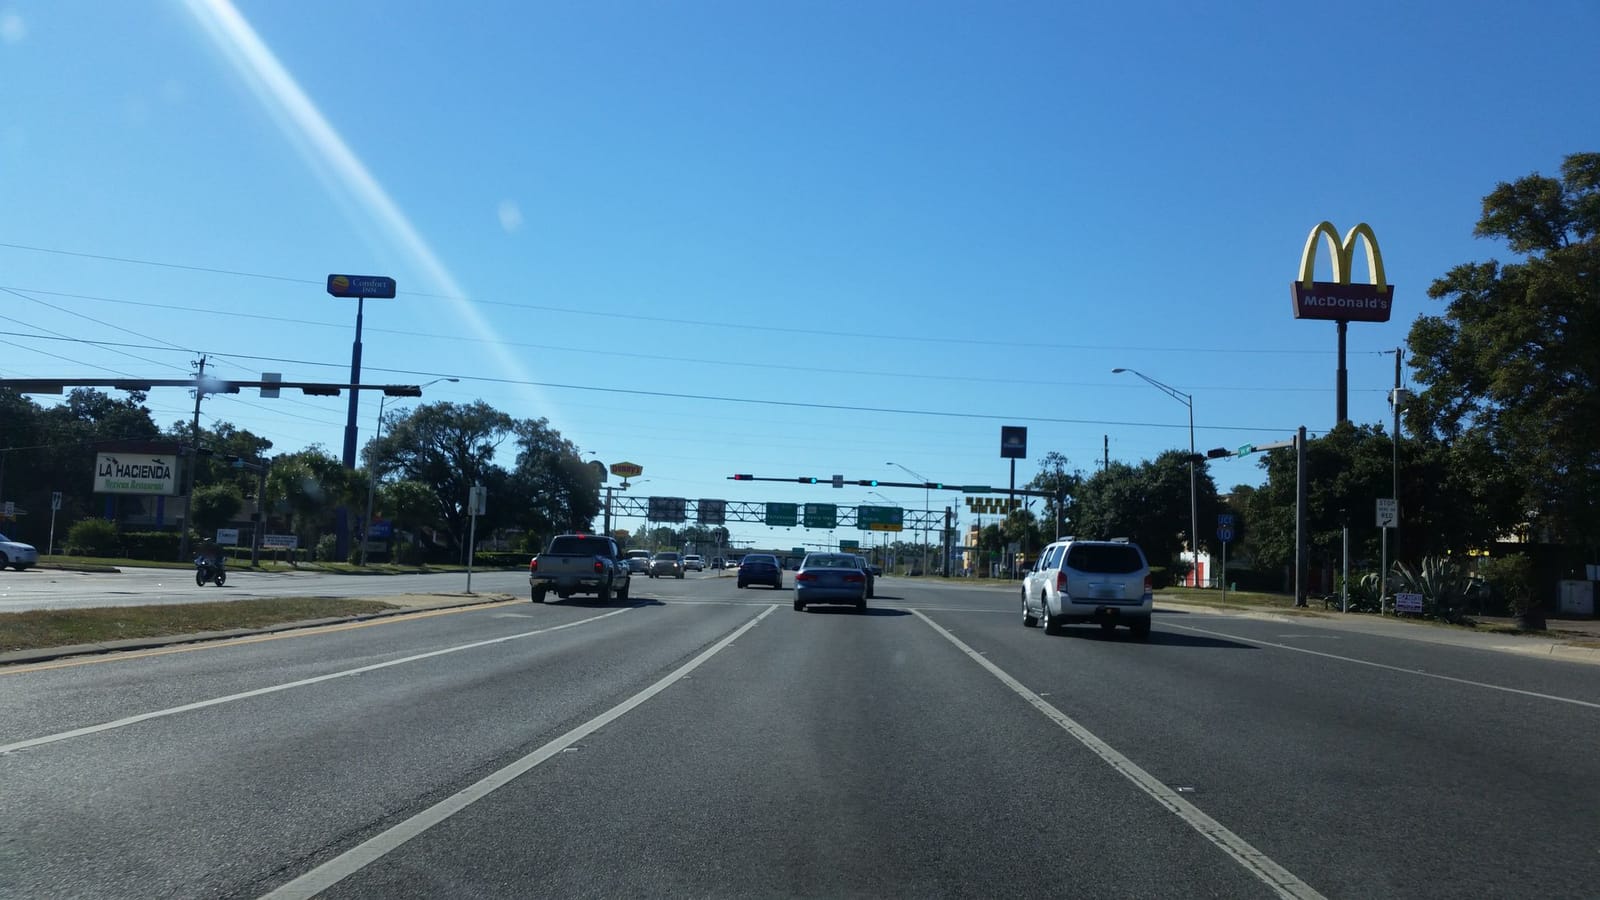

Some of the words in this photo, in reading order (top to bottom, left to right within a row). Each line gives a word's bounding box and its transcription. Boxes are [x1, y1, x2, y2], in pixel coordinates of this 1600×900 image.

[352, 279, 386, 289] Comfort
[1304, 295, 1388, 309] McDonald's
[99, 463, 113, 477] LA
[115, 464, 171, 479] HACIENDA
[1221, 529, 1232, 540] 10
